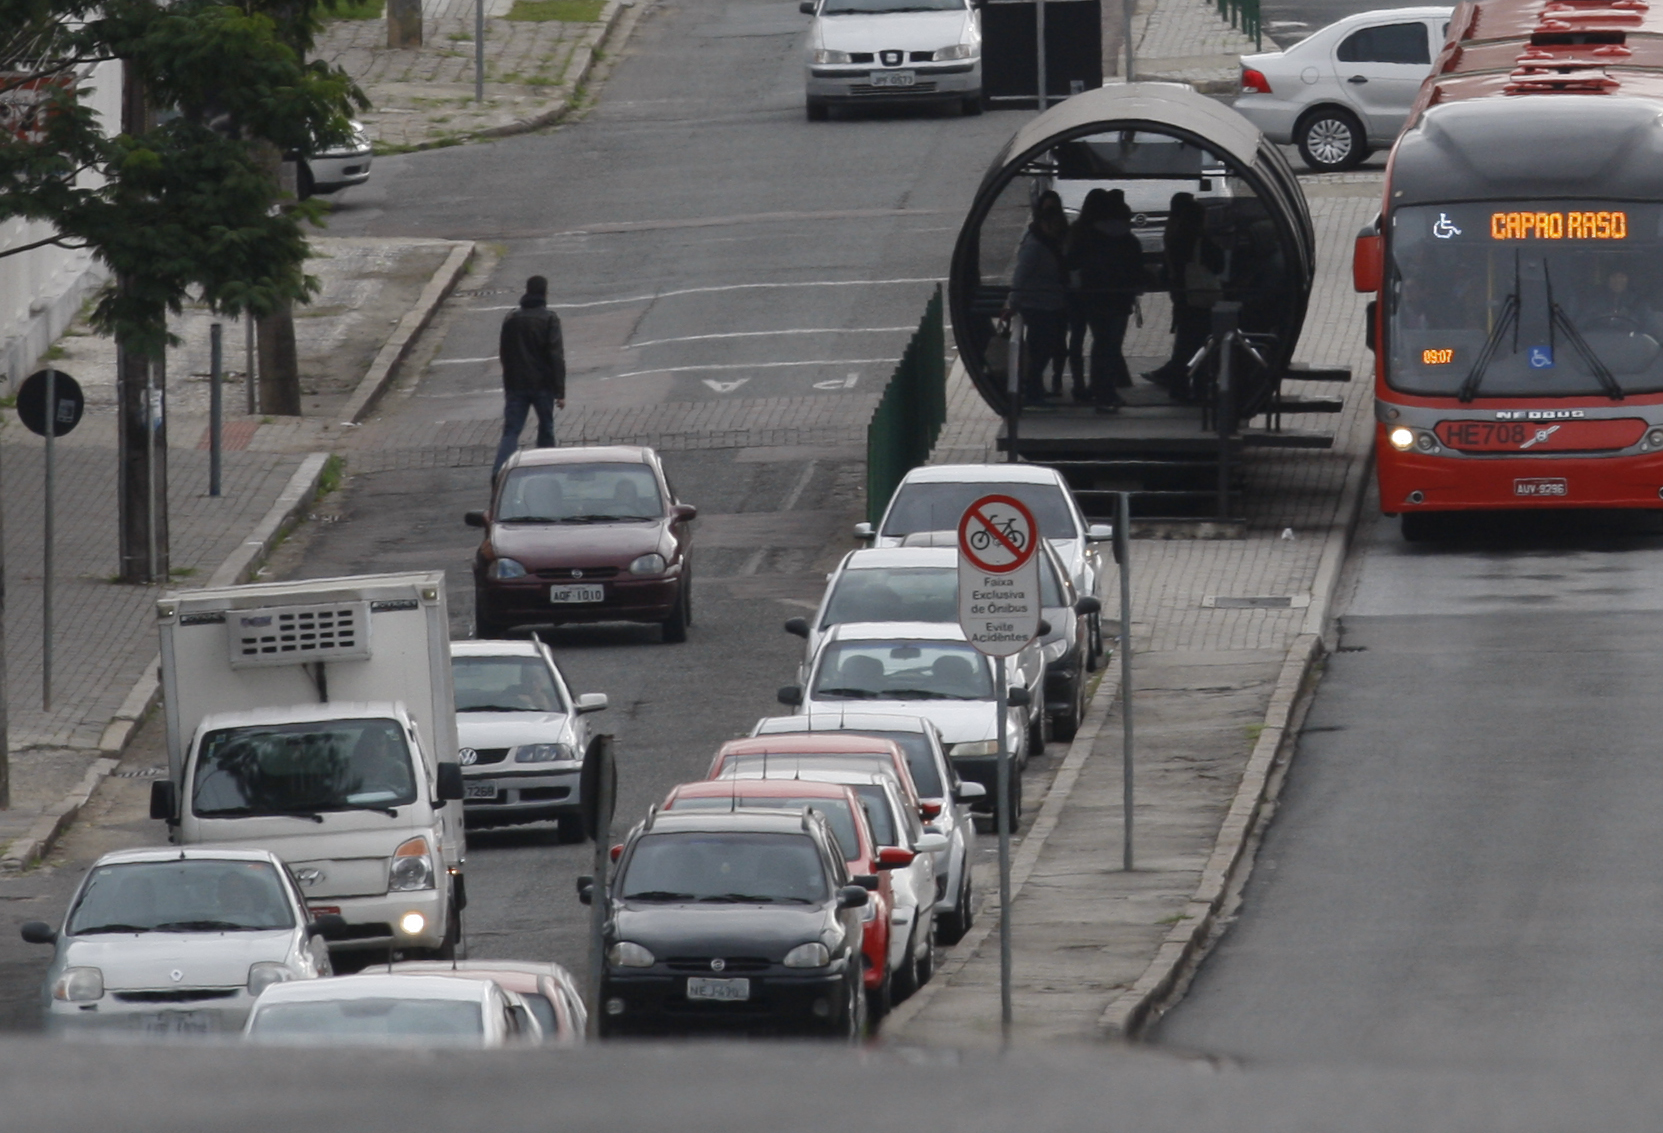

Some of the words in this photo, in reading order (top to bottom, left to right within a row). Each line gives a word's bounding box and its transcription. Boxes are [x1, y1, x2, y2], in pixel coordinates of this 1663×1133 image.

[1491, 211, 1564, 240] CAPAO
[1567, 211, 1628, 240] RASO
[1422, 349, 1454, 365] 09:07
[1446, 424, 1526, 446] HE708
[984, 577, 1014, 587] Faixa
[972, 590, 1025, 600] Exclusiva
[971, 604, 986, 614] de
[987, 602, 1028, 614] Ônibus
[985, 622, 1014, 632] Evite
[971, 633, 1030, 643] Acidentes
